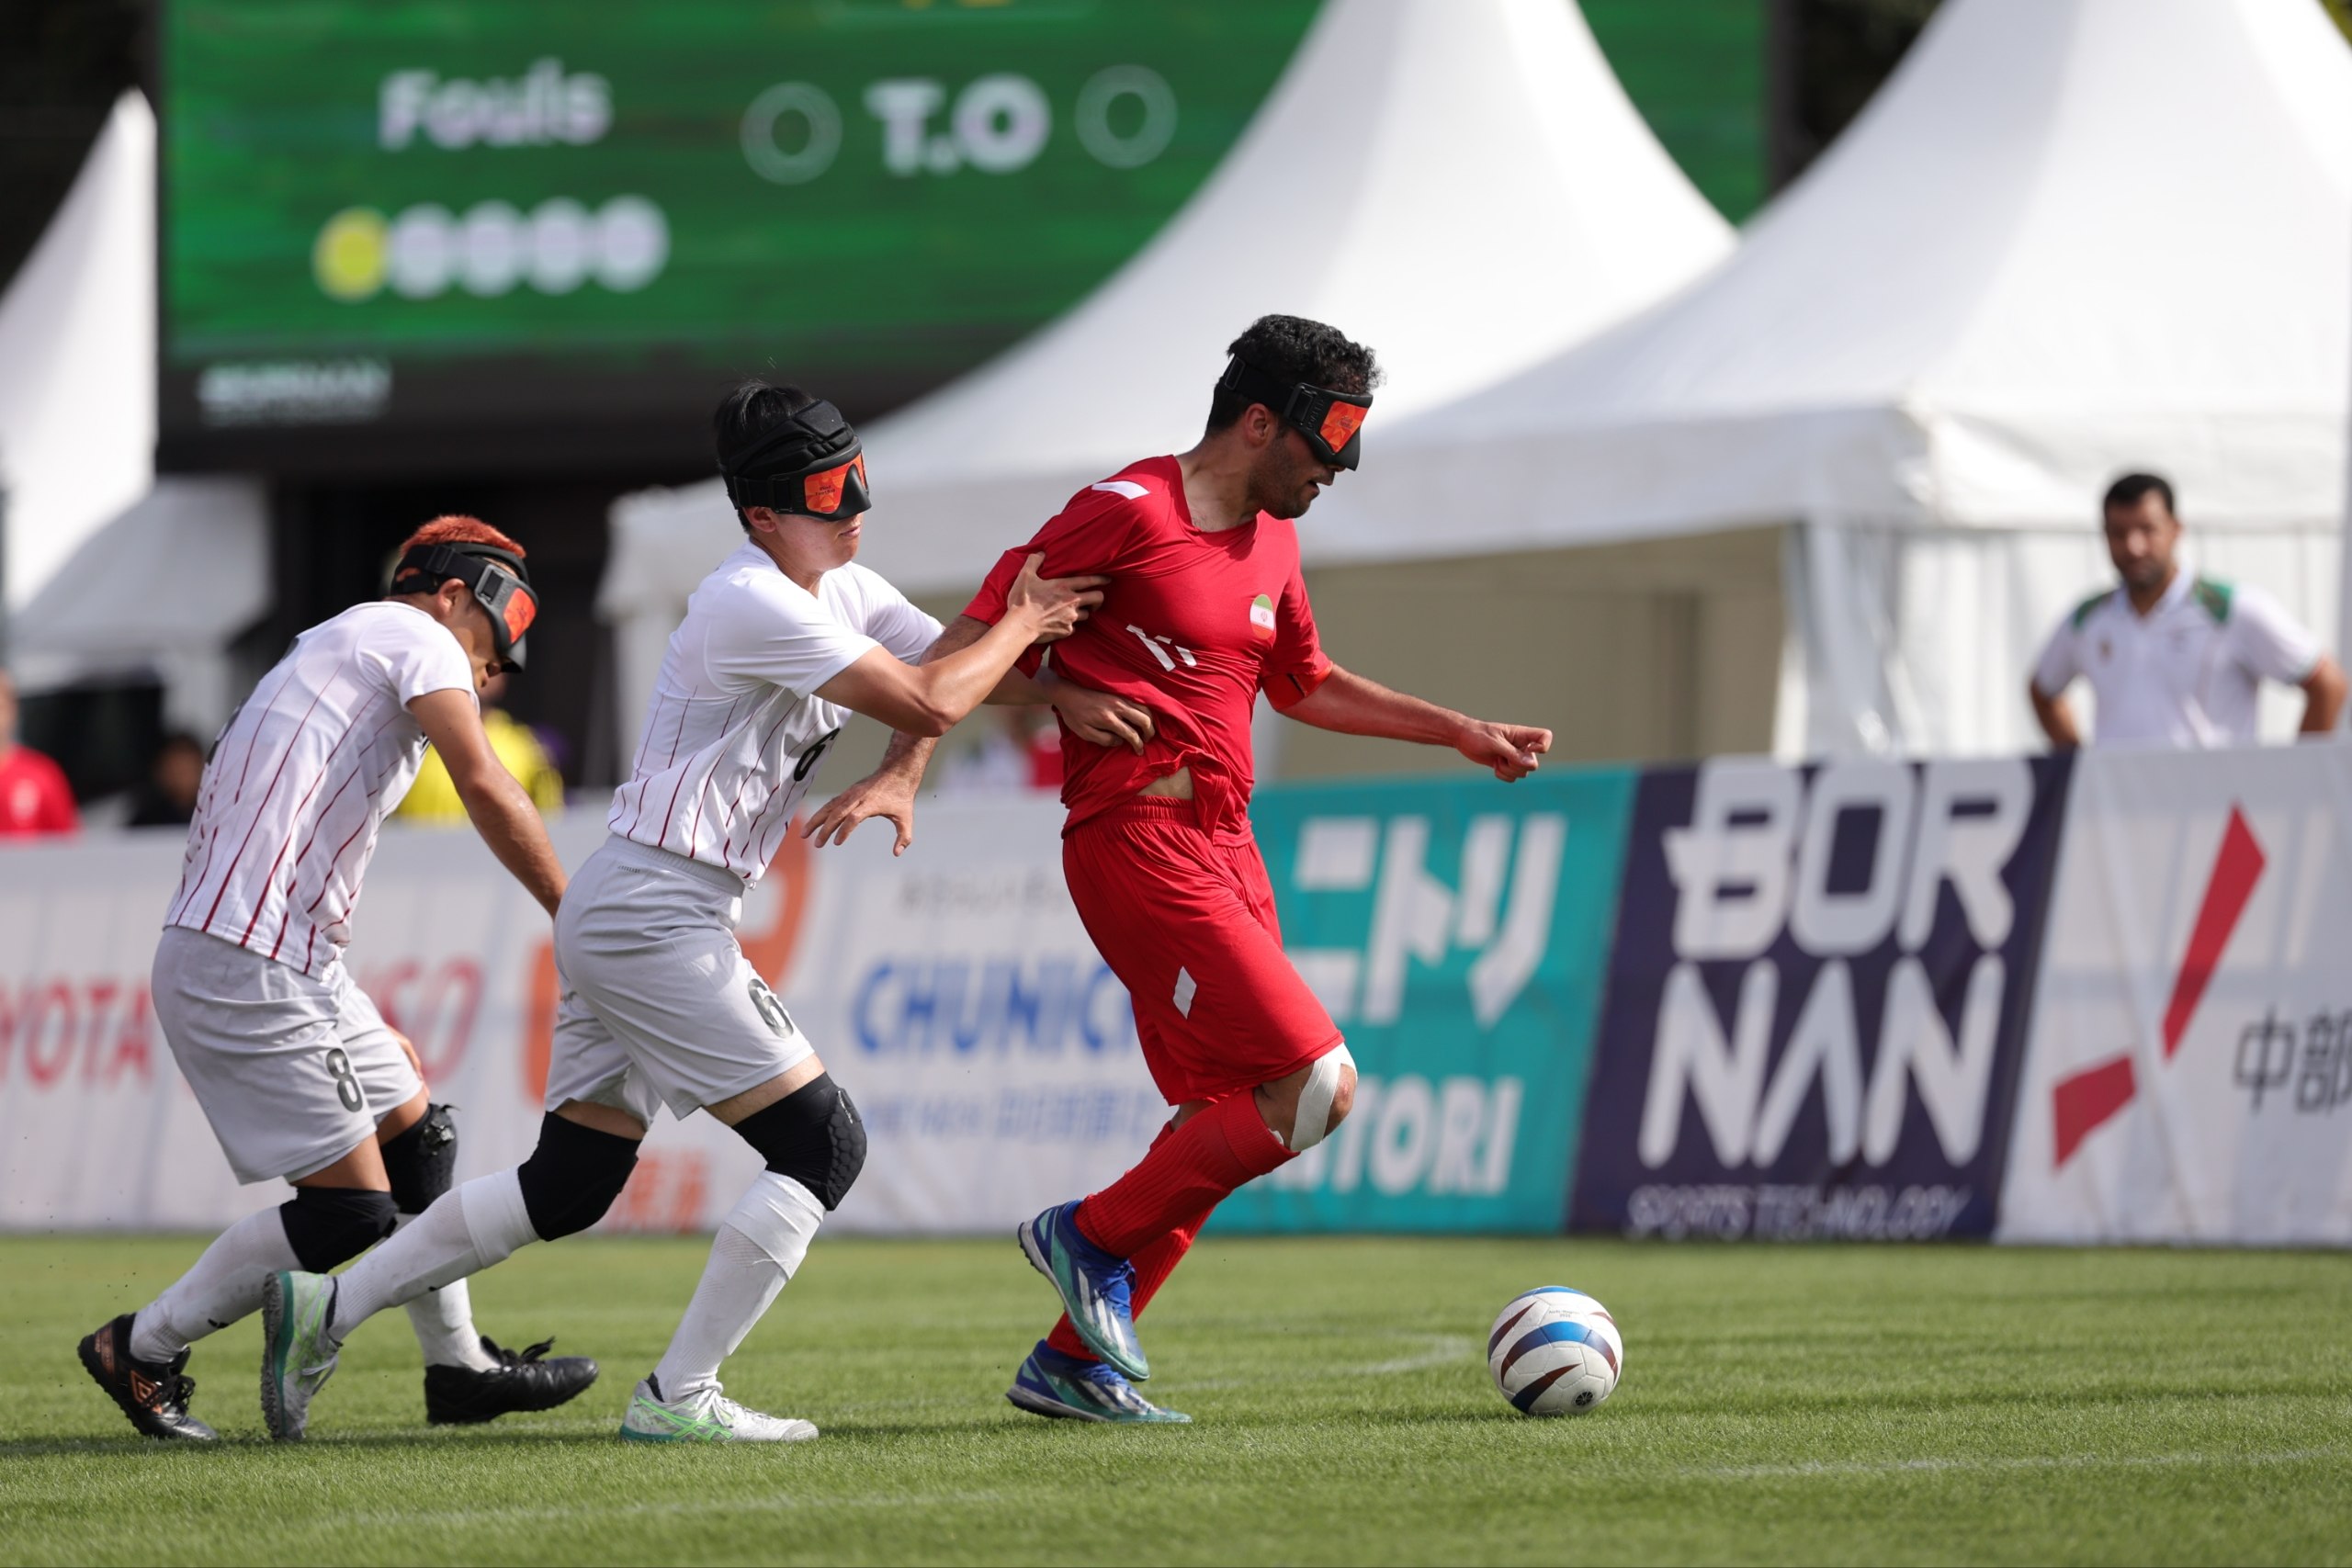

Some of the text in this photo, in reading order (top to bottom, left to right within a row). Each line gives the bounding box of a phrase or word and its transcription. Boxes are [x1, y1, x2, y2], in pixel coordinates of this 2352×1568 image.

[379, 58, 614, 151] Fouls
[865, 73, 1051, 175] T.O
[1662, 753, 2036, 959] BOR
[1283, 812, 1566, 1031] ニトリ
[747, 978, 794, 1039] 6
[325, 1047, 364, 1112] 8
[1263, 1073, 1525, 1196] TORI
